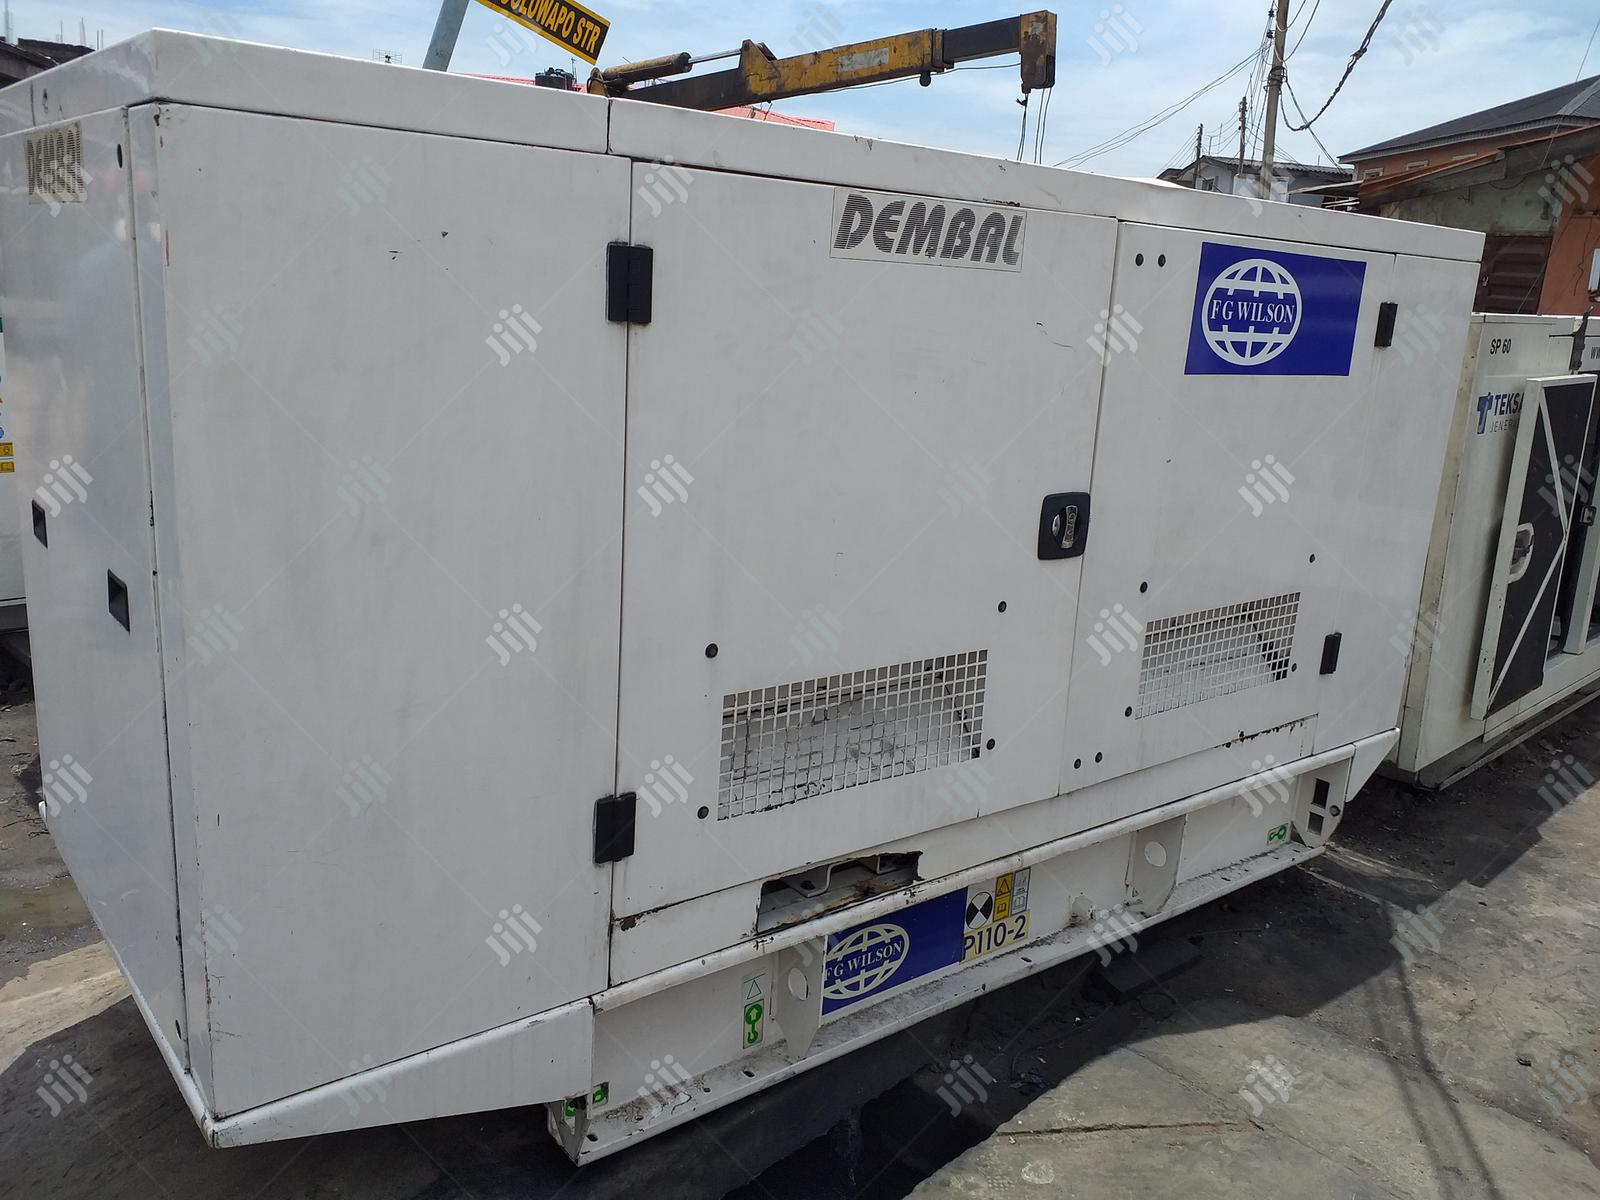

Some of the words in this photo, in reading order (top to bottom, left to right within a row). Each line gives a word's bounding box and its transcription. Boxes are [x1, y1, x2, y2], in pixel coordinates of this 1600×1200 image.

[573, 17, 601, 53] STR
[833, 193, 1024, 265] DEMBAL
[1237, 301, 1295, 323] WILSON
[1490, 339, 1501, 354] SP
[1502, 338, 1512, 354] 60
[963, 914, 1026, 960] P110-2
[847, 940, 903, 971] WILSON
